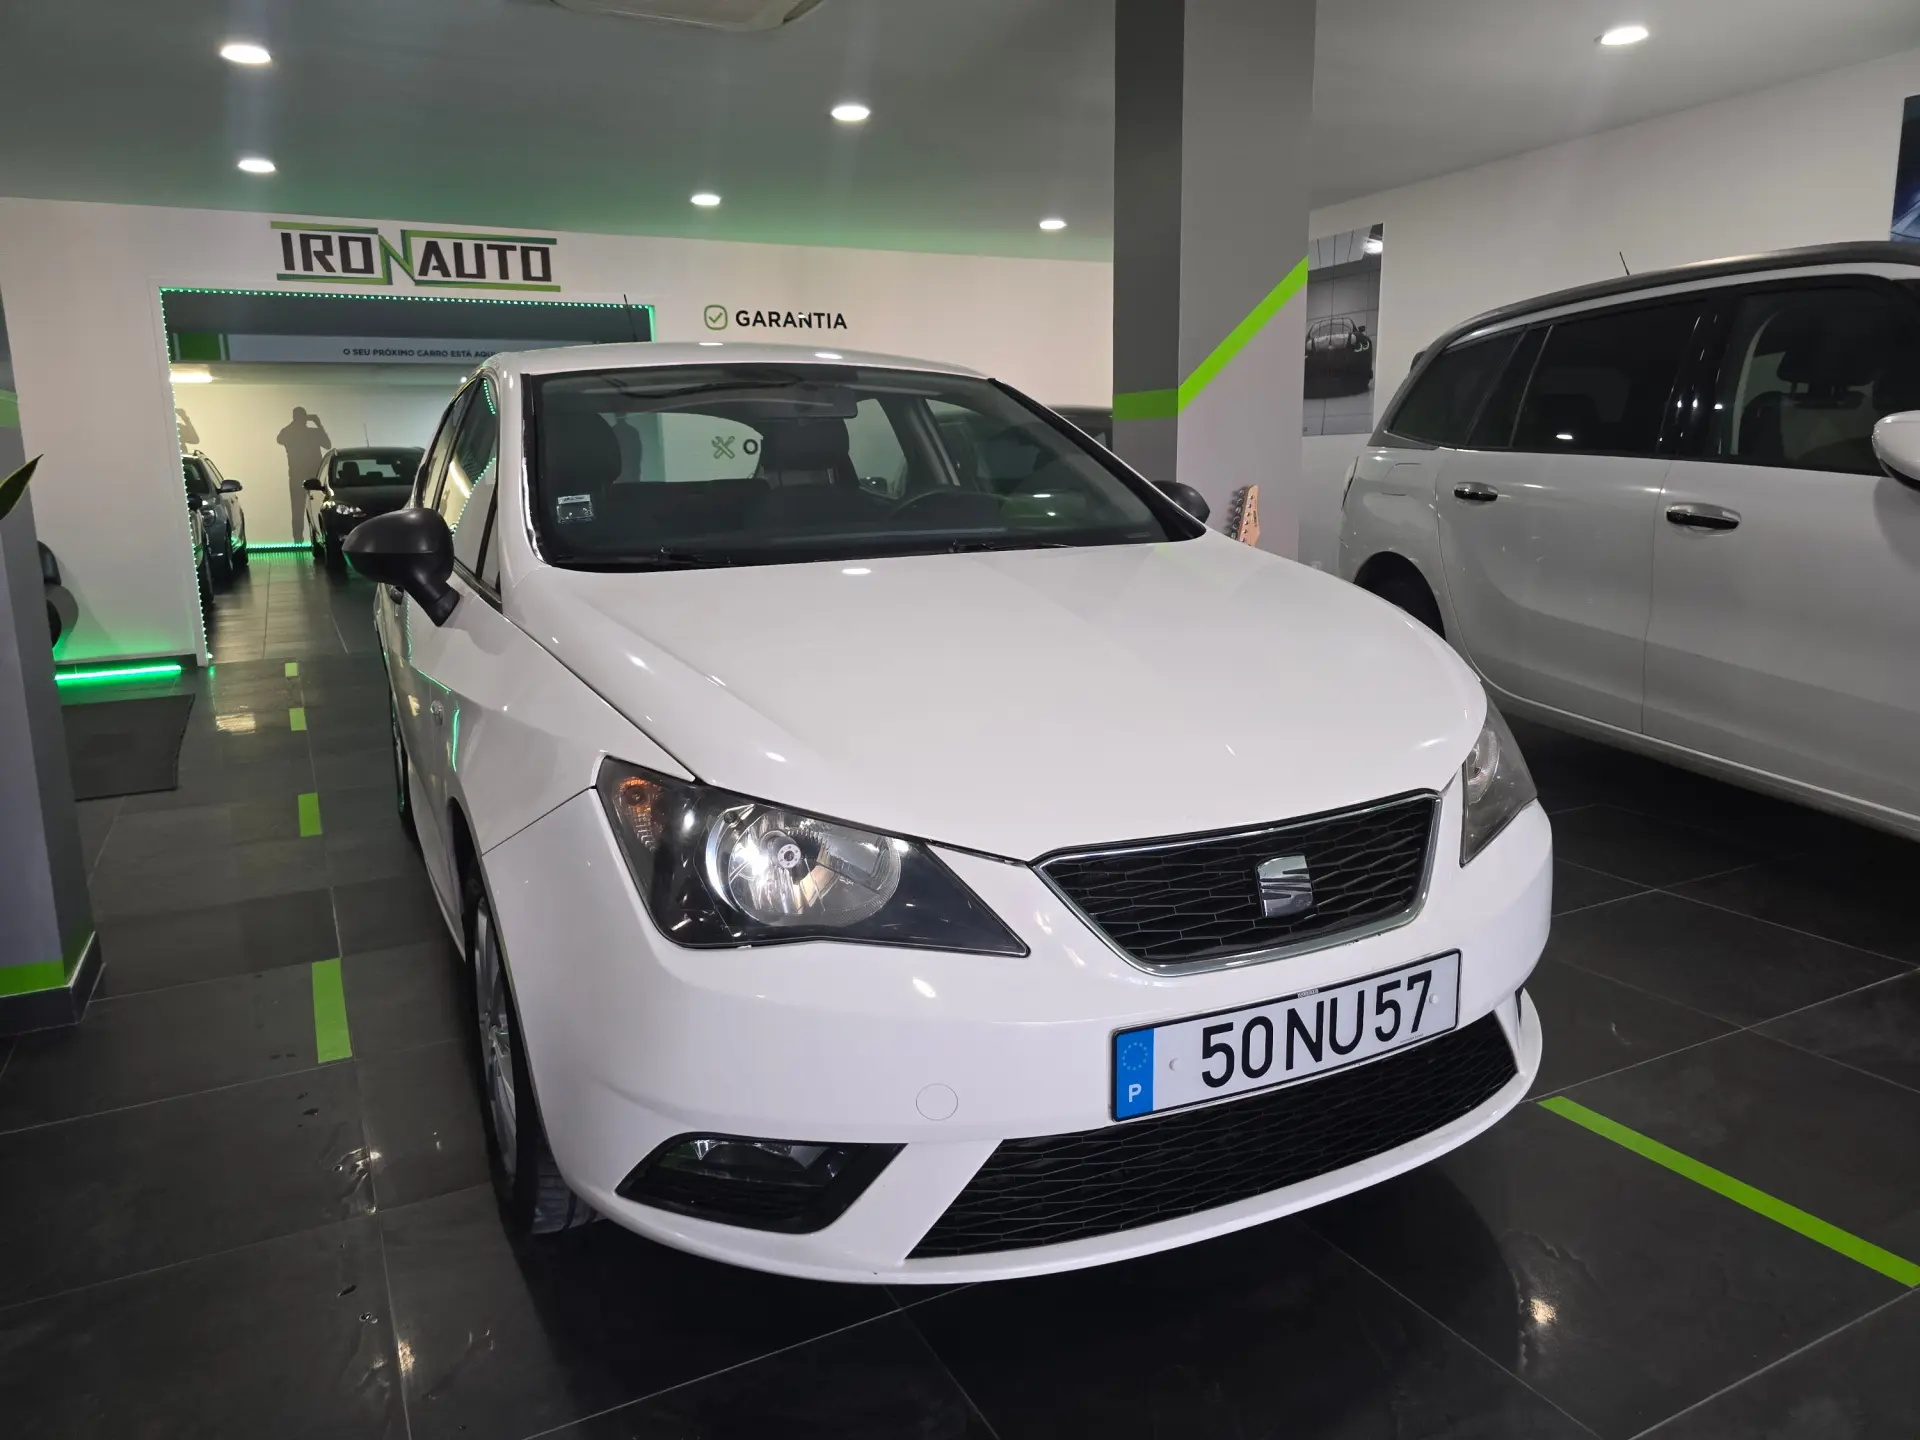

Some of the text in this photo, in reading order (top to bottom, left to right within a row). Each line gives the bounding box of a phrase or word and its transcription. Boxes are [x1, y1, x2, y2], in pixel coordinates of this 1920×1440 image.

[735, 310, 848, 330] GARANTIA
[343, 348, 351, 356] O
[353, 348, 370, 357] SEU
[373, 347, 415, 357] PRÓXIMO
[417, 349, 448, 358] CARRO
[450, 348, 472, 358] ESTÁ
[1128, 1083, 1142, 1103] P
